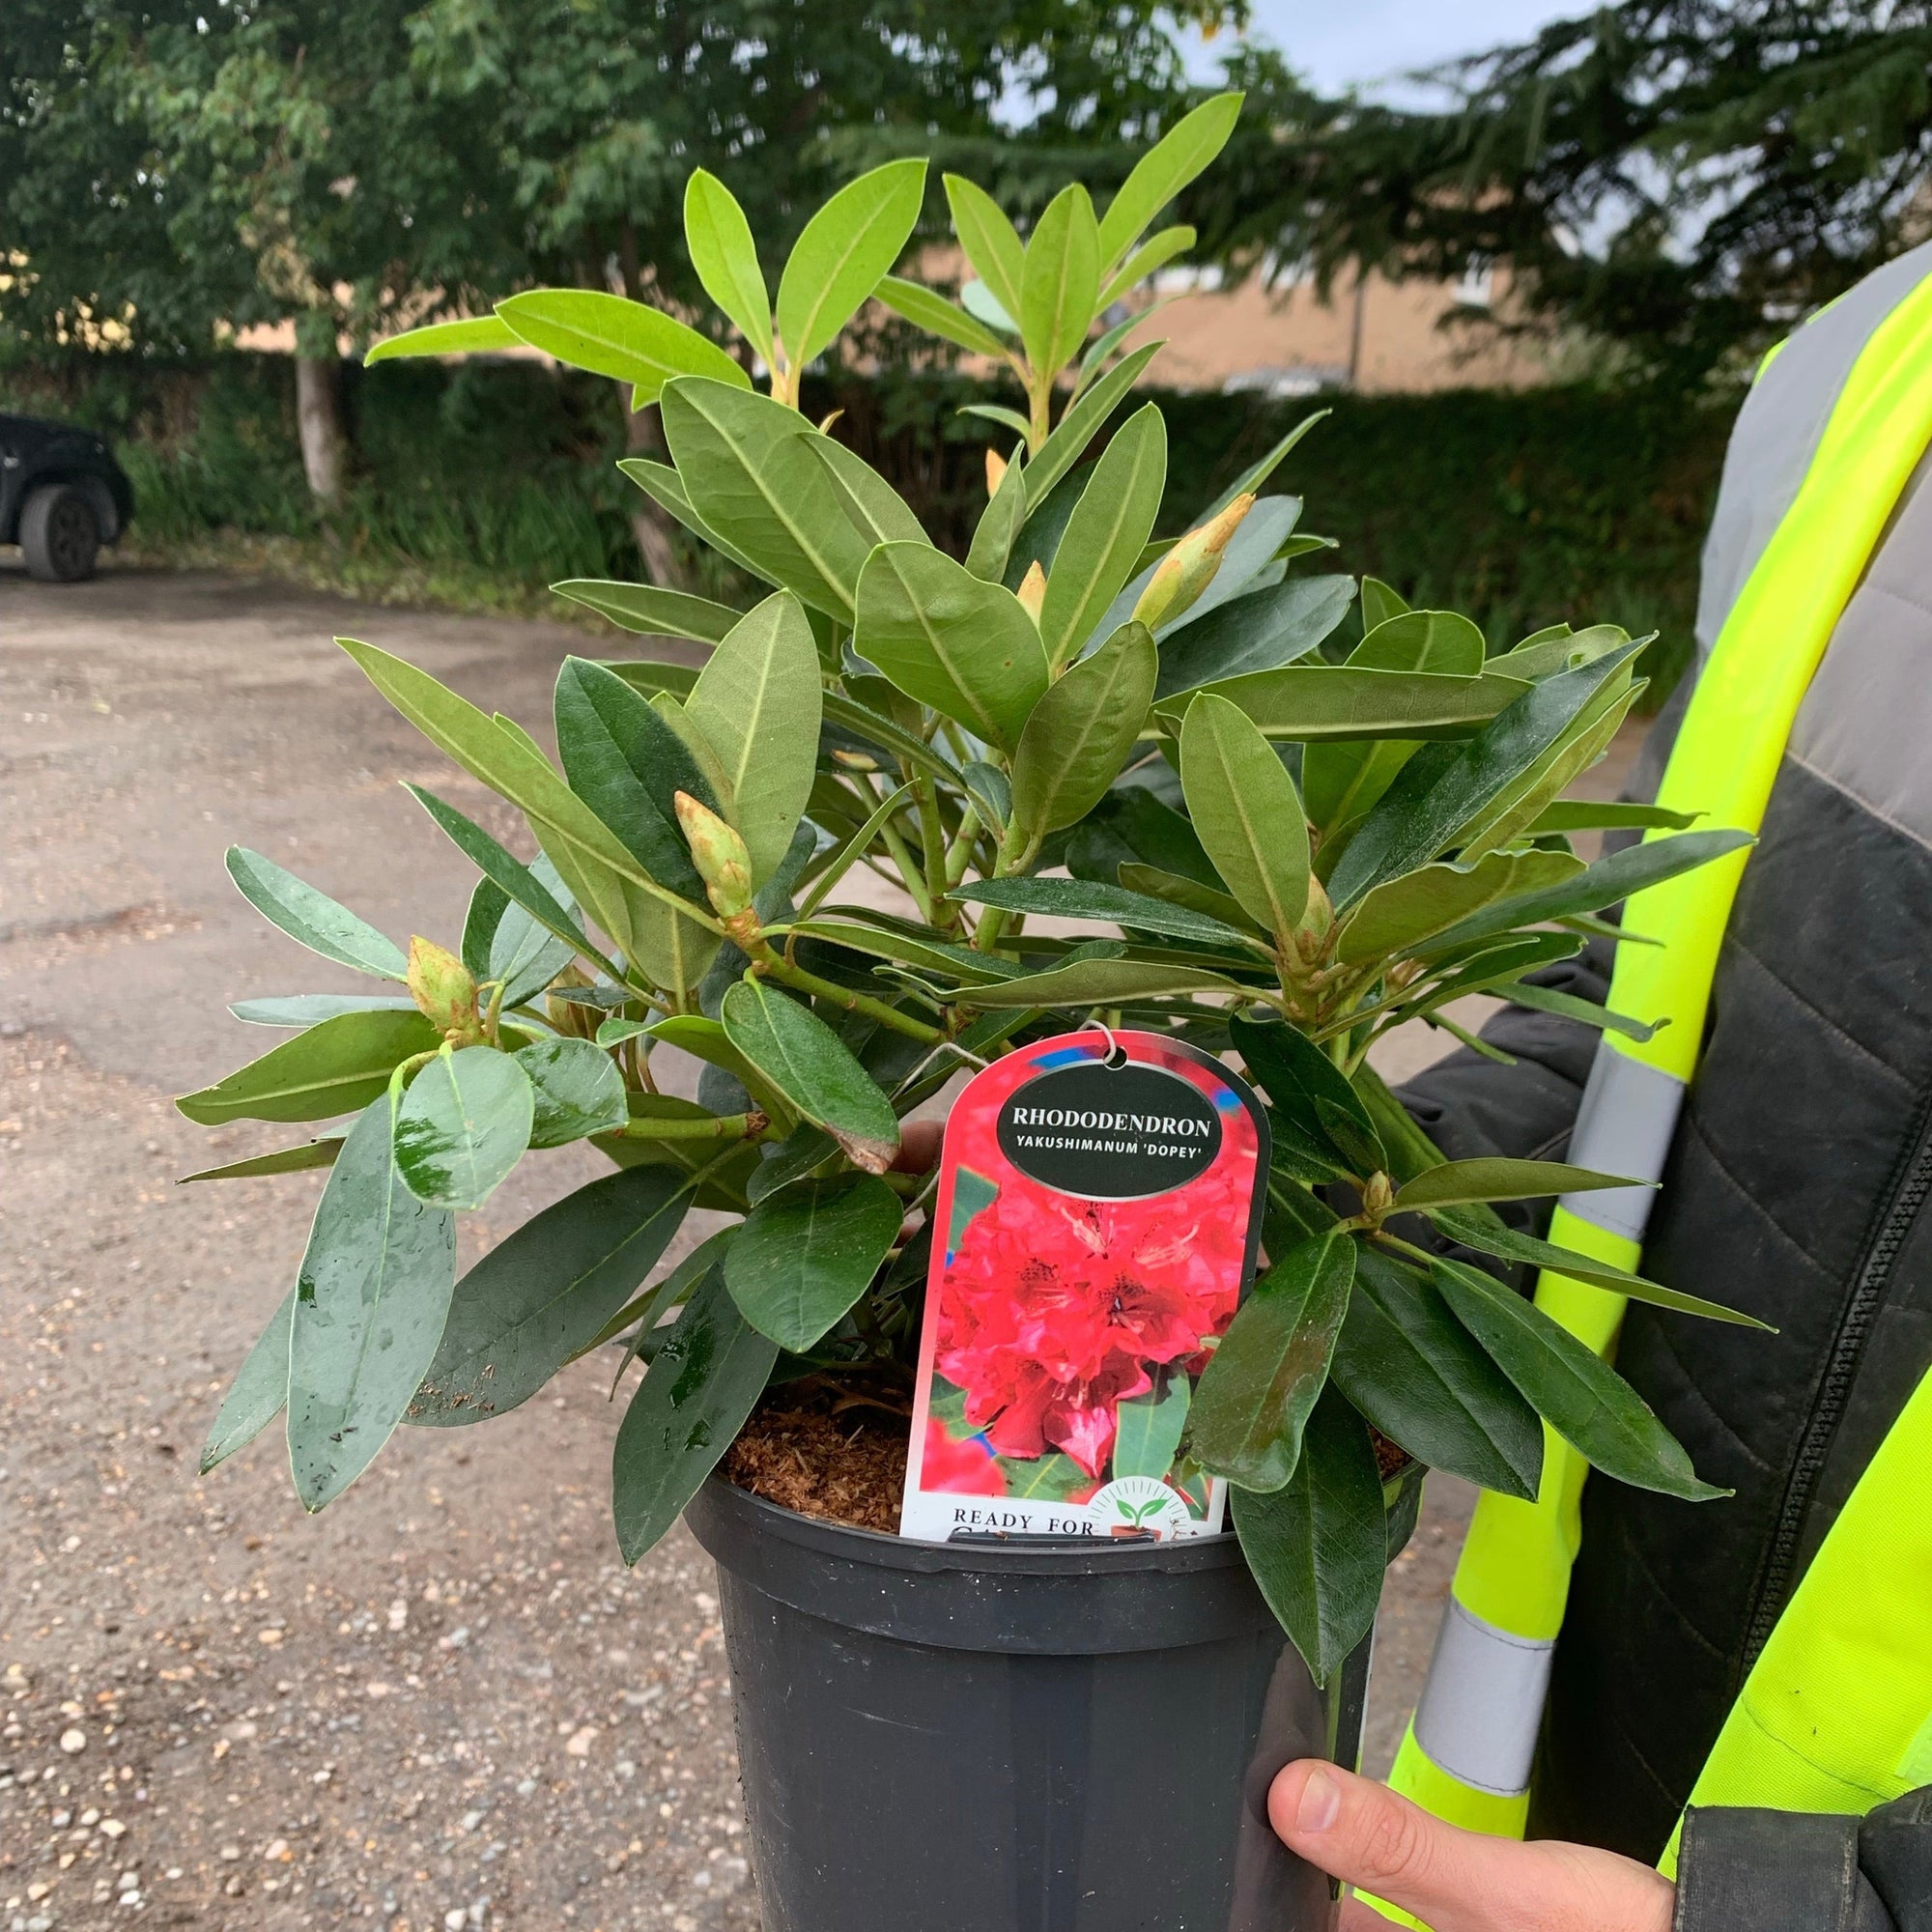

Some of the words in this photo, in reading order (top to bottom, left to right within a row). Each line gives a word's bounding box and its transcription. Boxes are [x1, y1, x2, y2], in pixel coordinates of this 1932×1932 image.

[1012, 1107, 1211, 1137] RHODODENDRON
[1016, 1135, 1138, 1154] YAKUSHIMANUM
[1143, 1143, 1202, 1159] 'DOPEY'
[953, 1507, 1033, 1529] READY
[1049, 1518, 1094, 1536] FOR
